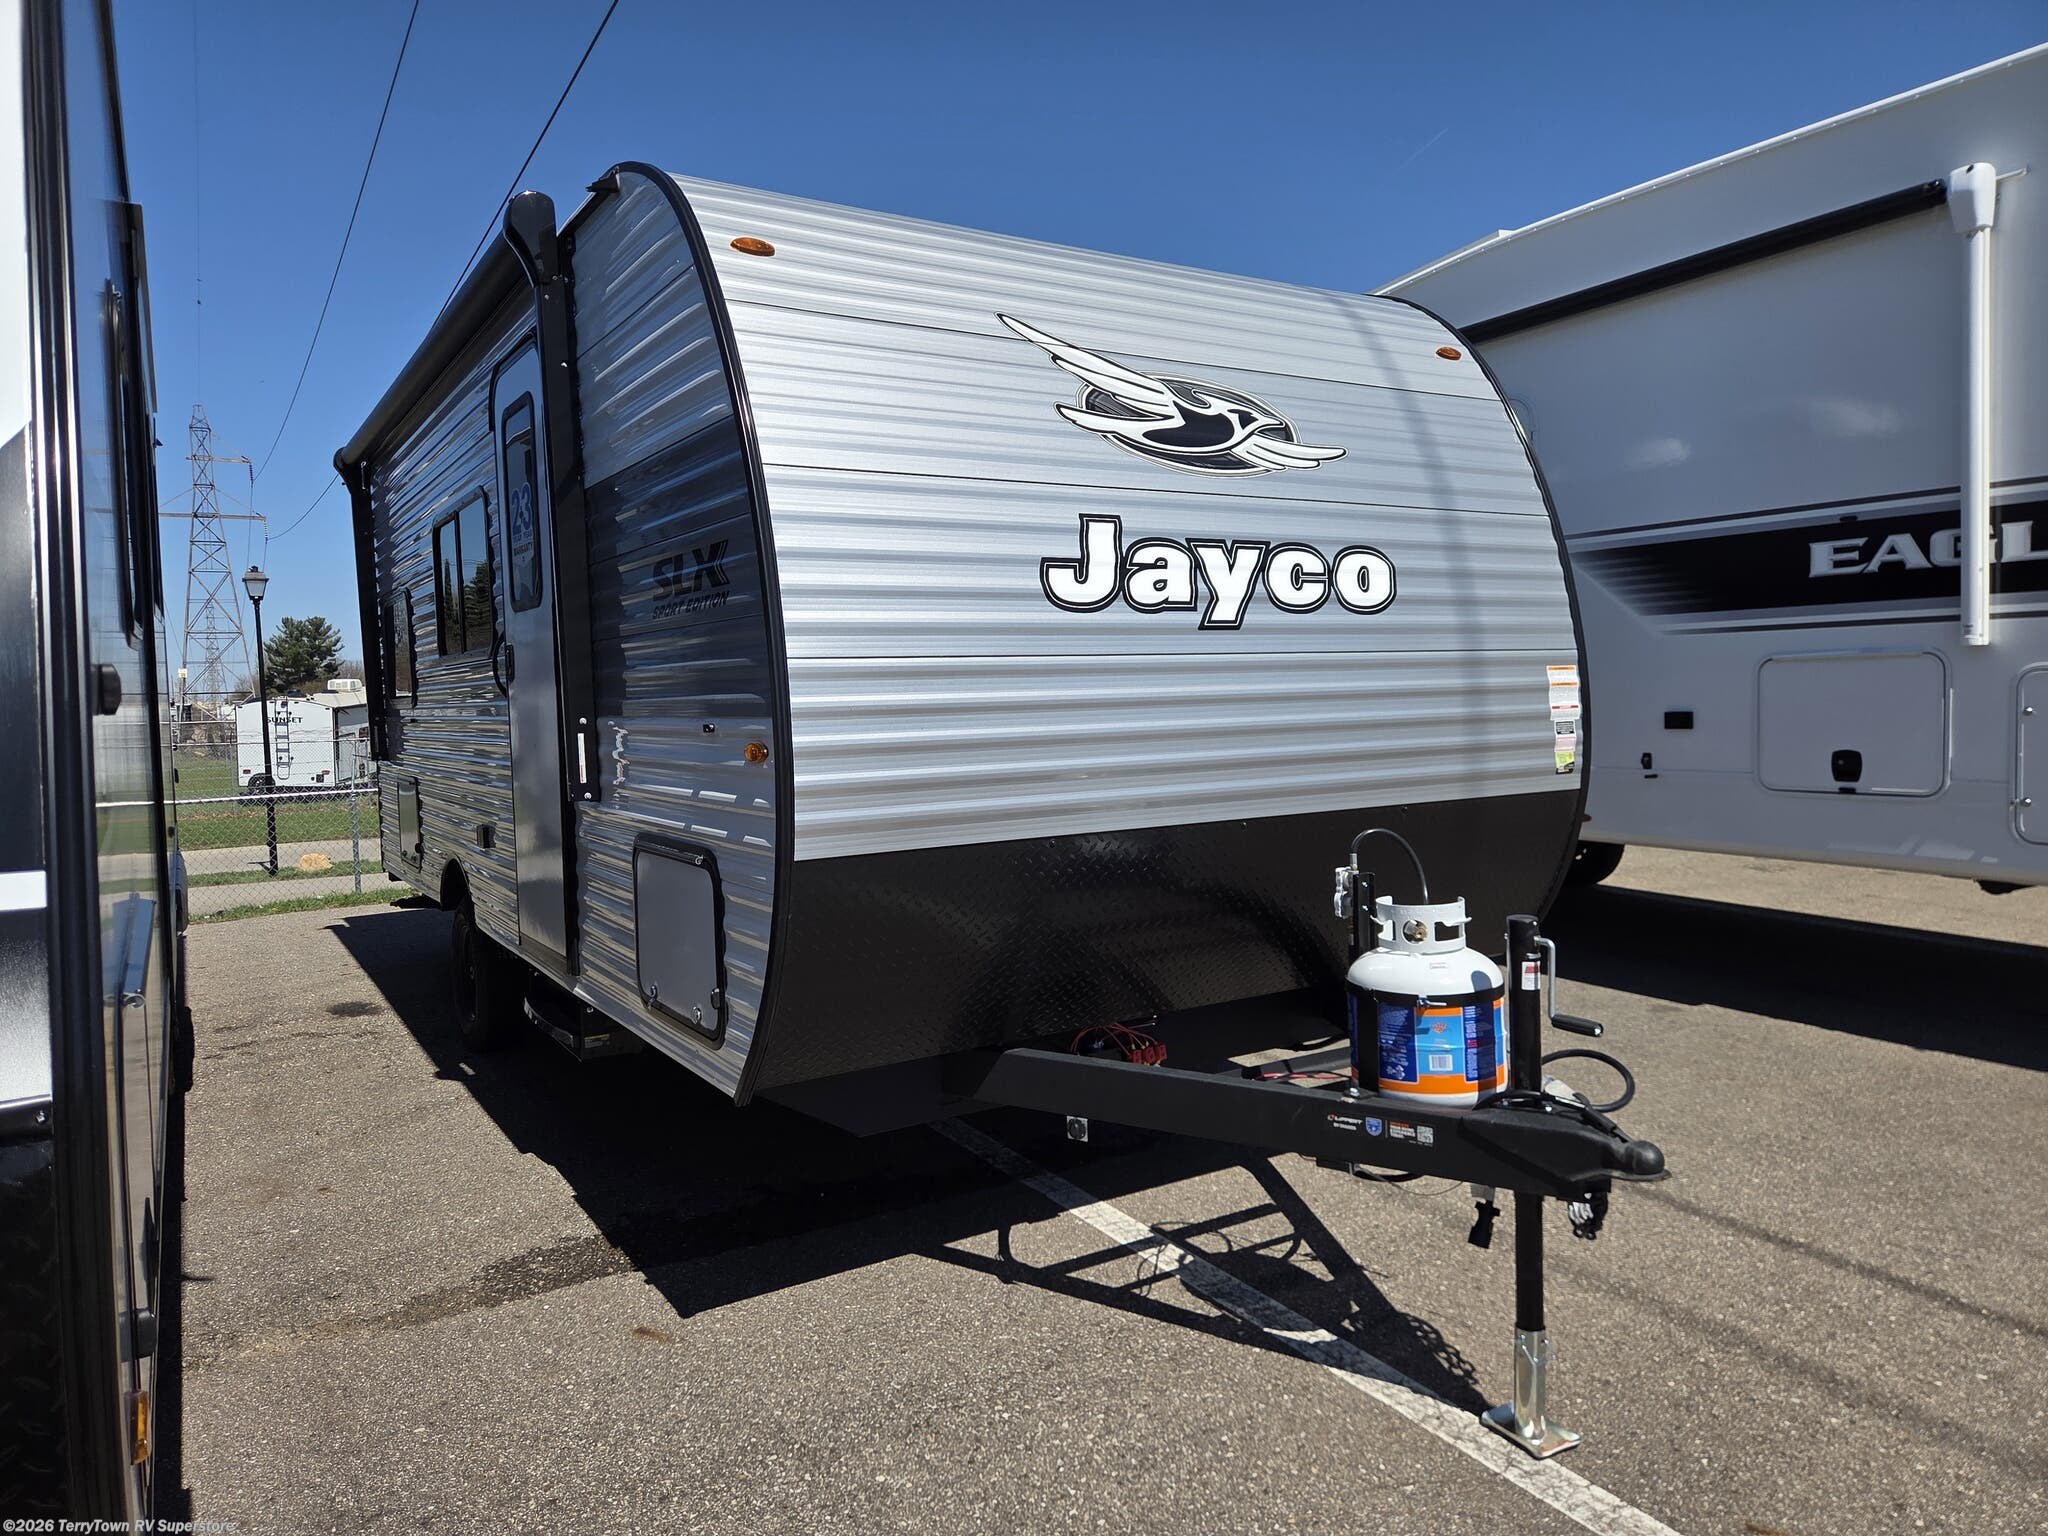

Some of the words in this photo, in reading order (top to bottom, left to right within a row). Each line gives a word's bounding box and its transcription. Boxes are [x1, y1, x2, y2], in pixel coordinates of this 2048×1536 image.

[653, 539, 730, 601] SLX
[1040, 513, 1397, 630] Jayco
[652, 600, 685, 619] SPORT
[686, 590, 730, 613] EDITION
